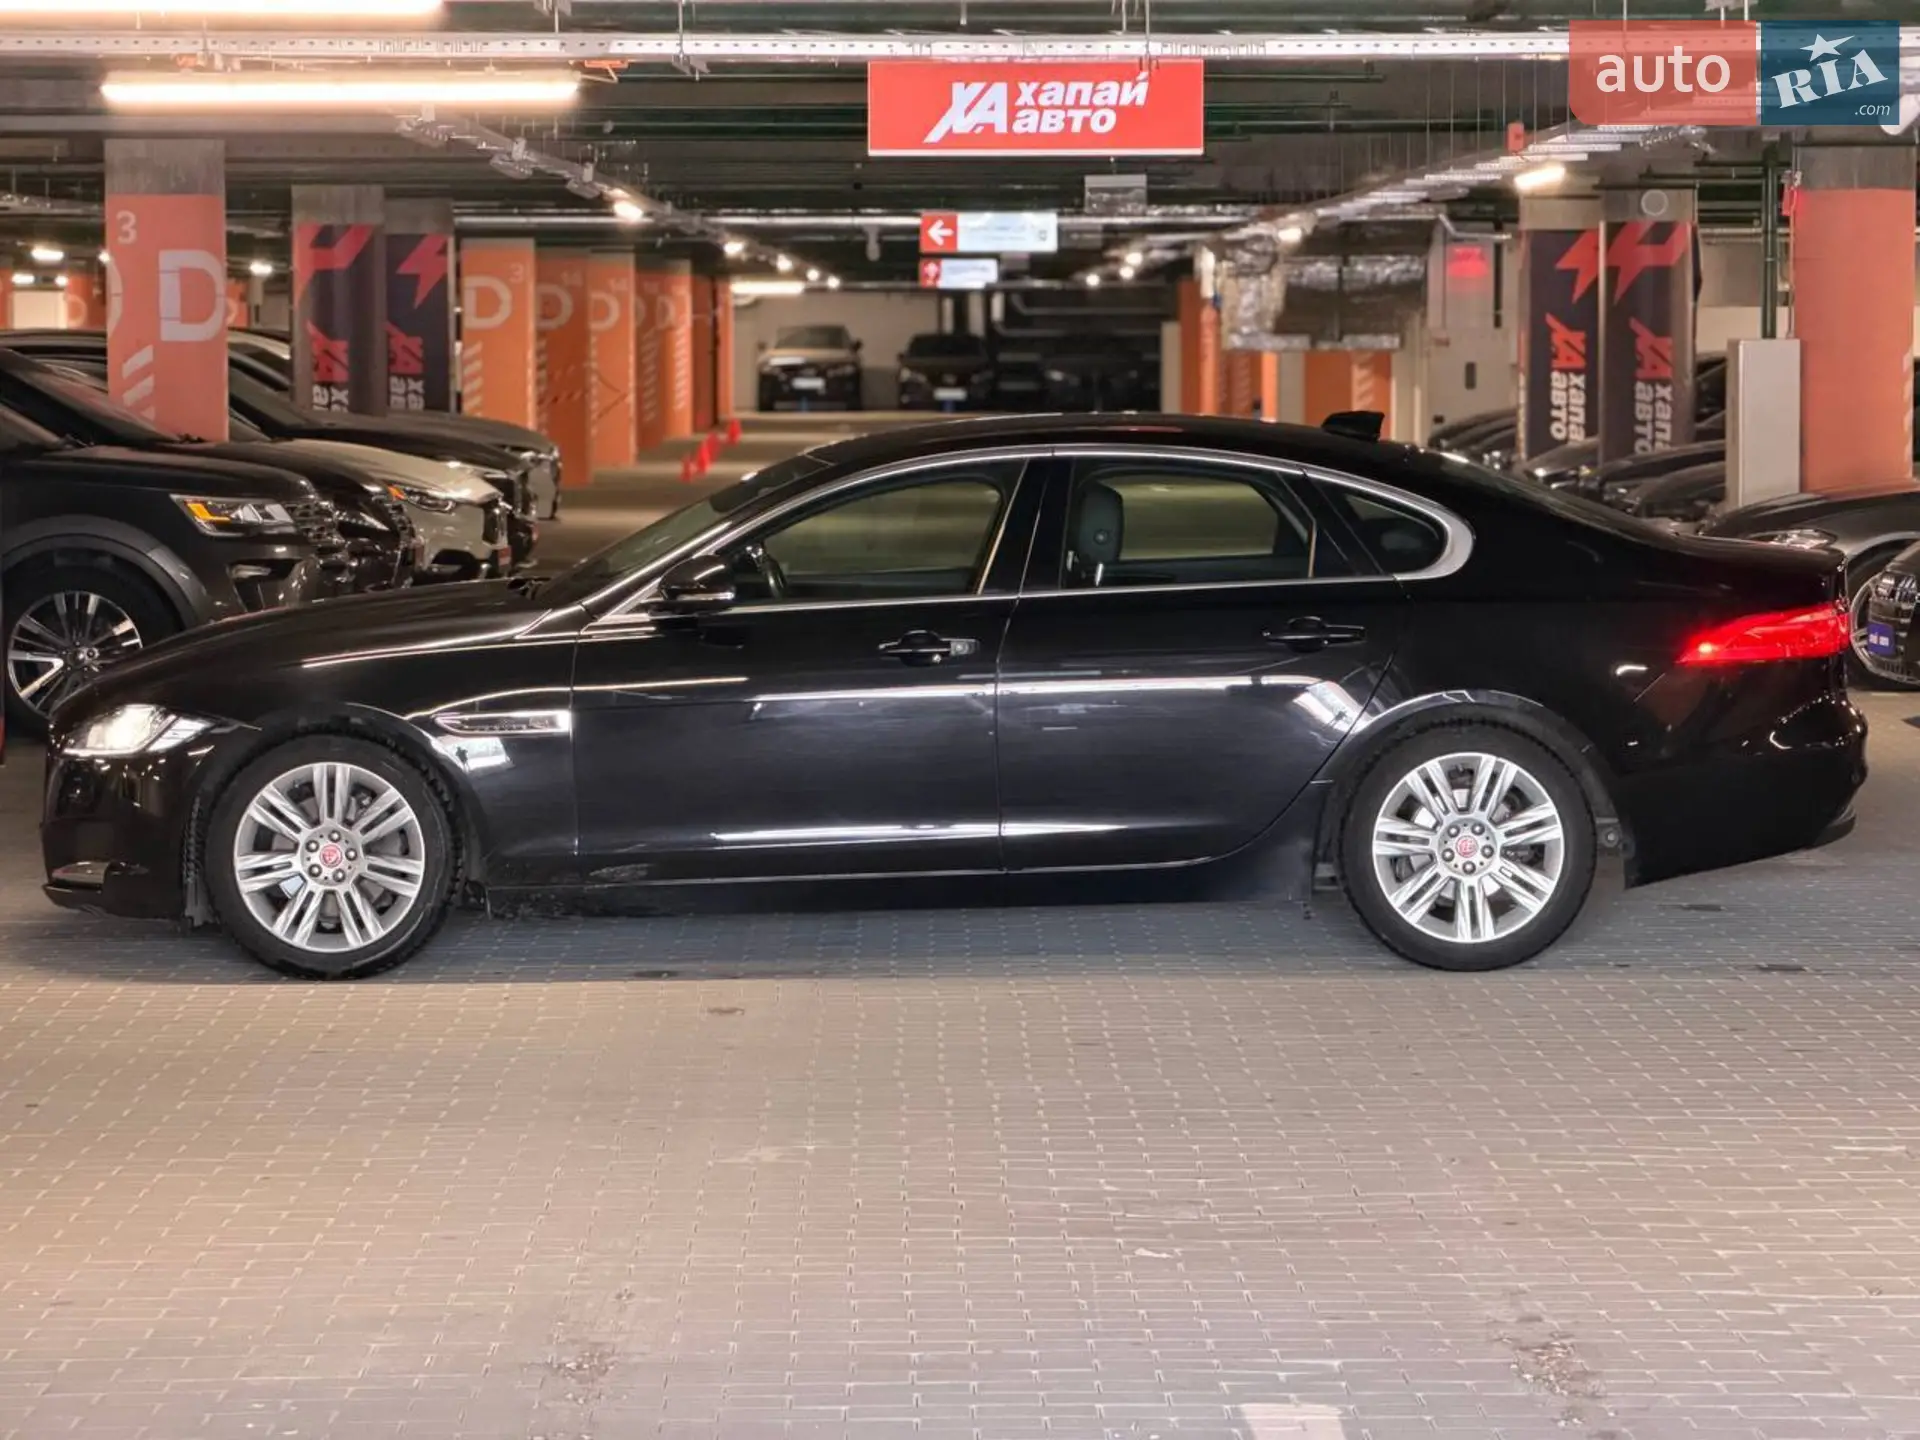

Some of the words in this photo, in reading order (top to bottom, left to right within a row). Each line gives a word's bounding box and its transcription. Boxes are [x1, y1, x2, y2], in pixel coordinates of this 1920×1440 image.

[1015, 72, 1149, 106] хапай
[1012, 108, 1117, 133] авто
[116, 210, 137, 244] 3
[158, 249, 225, 342] D
[460, 275, 513, 330] D
[509, 263, 525, 283] 3
